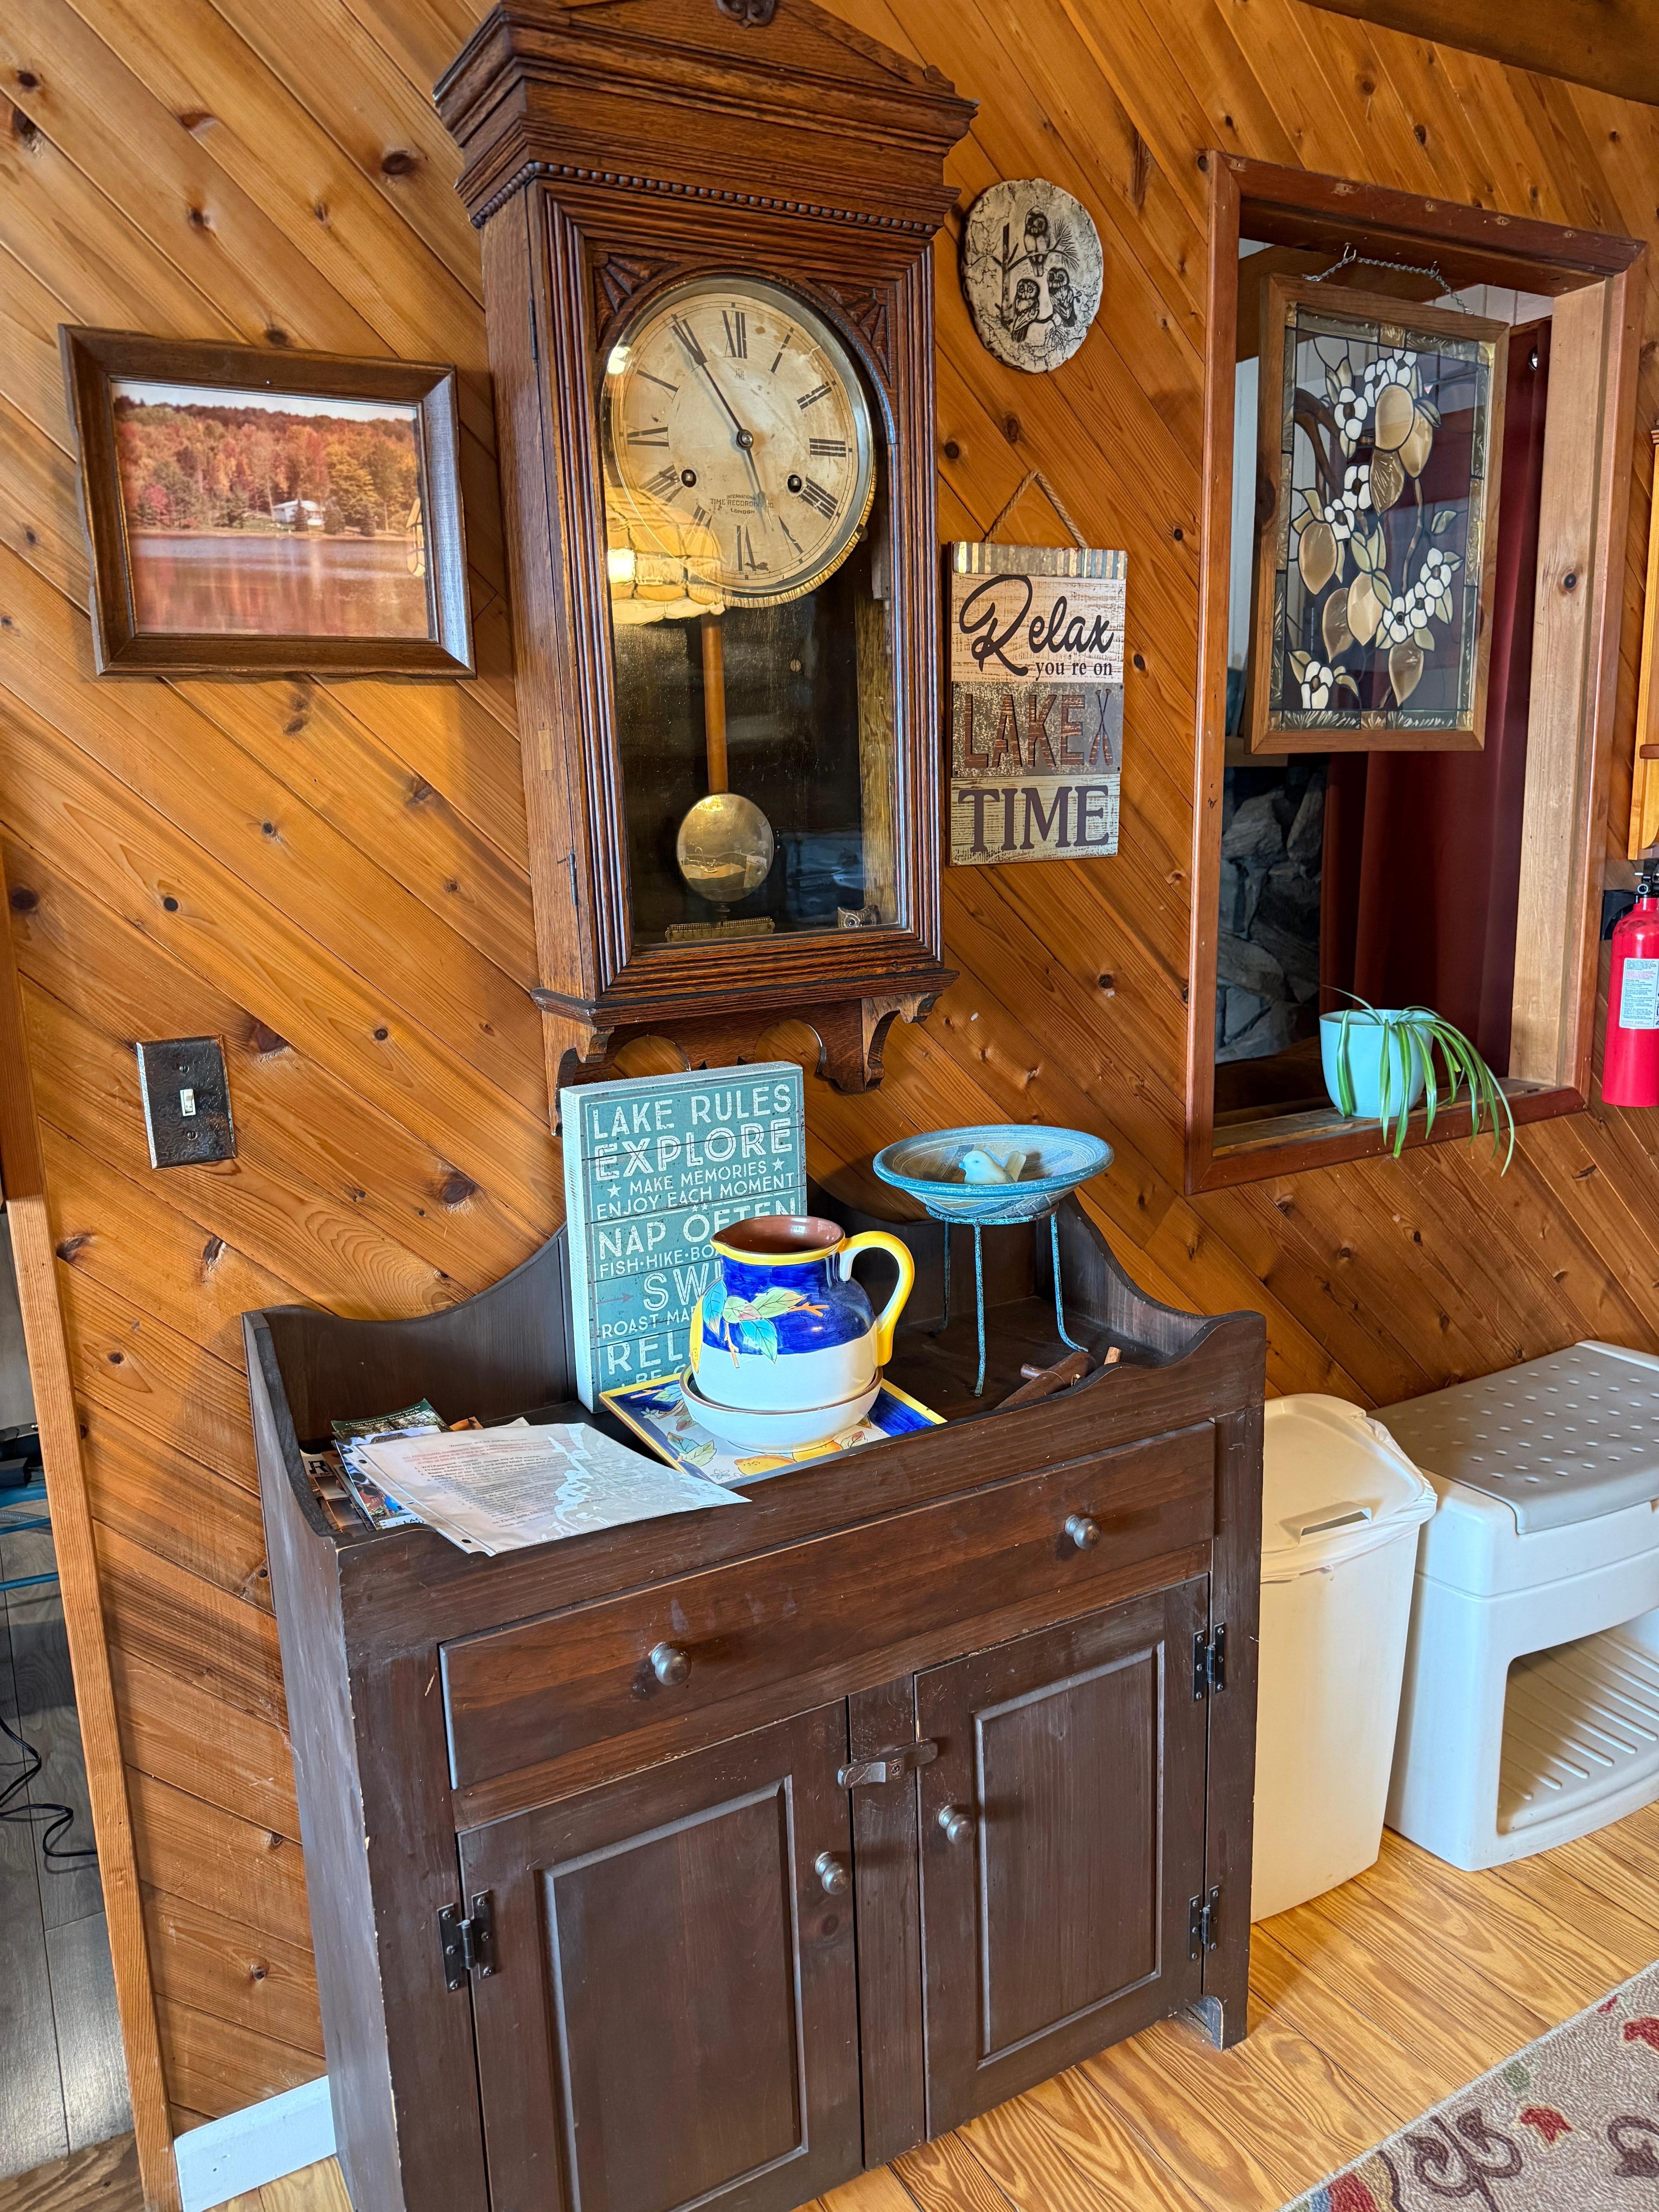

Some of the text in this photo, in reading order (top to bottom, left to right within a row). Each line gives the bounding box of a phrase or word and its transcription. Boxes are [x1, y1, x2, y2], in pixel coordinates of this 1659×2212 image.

[958, 574, 1115, 677] Relax
[1092, 662, 1113, 676] on
[964, 694, 1086, 769] LAKE
[958, 785, 1109, 854] TIME
[592, 1084, 792, 1139] LAKE RULES
[594, 1117, 792, 1182] EXPLORE
[596, 1172, 795, 1220] ENJOY EACH MOMENT
[630, 1160, 767, 1196] MAKE MEMORIES
[598, 1221, 666, 1260] NAP
[690, 1244, 719, 1261] BO
[601, 1313, 659, 1339] ROAST
[606, 1329, 690, 1375] REL
